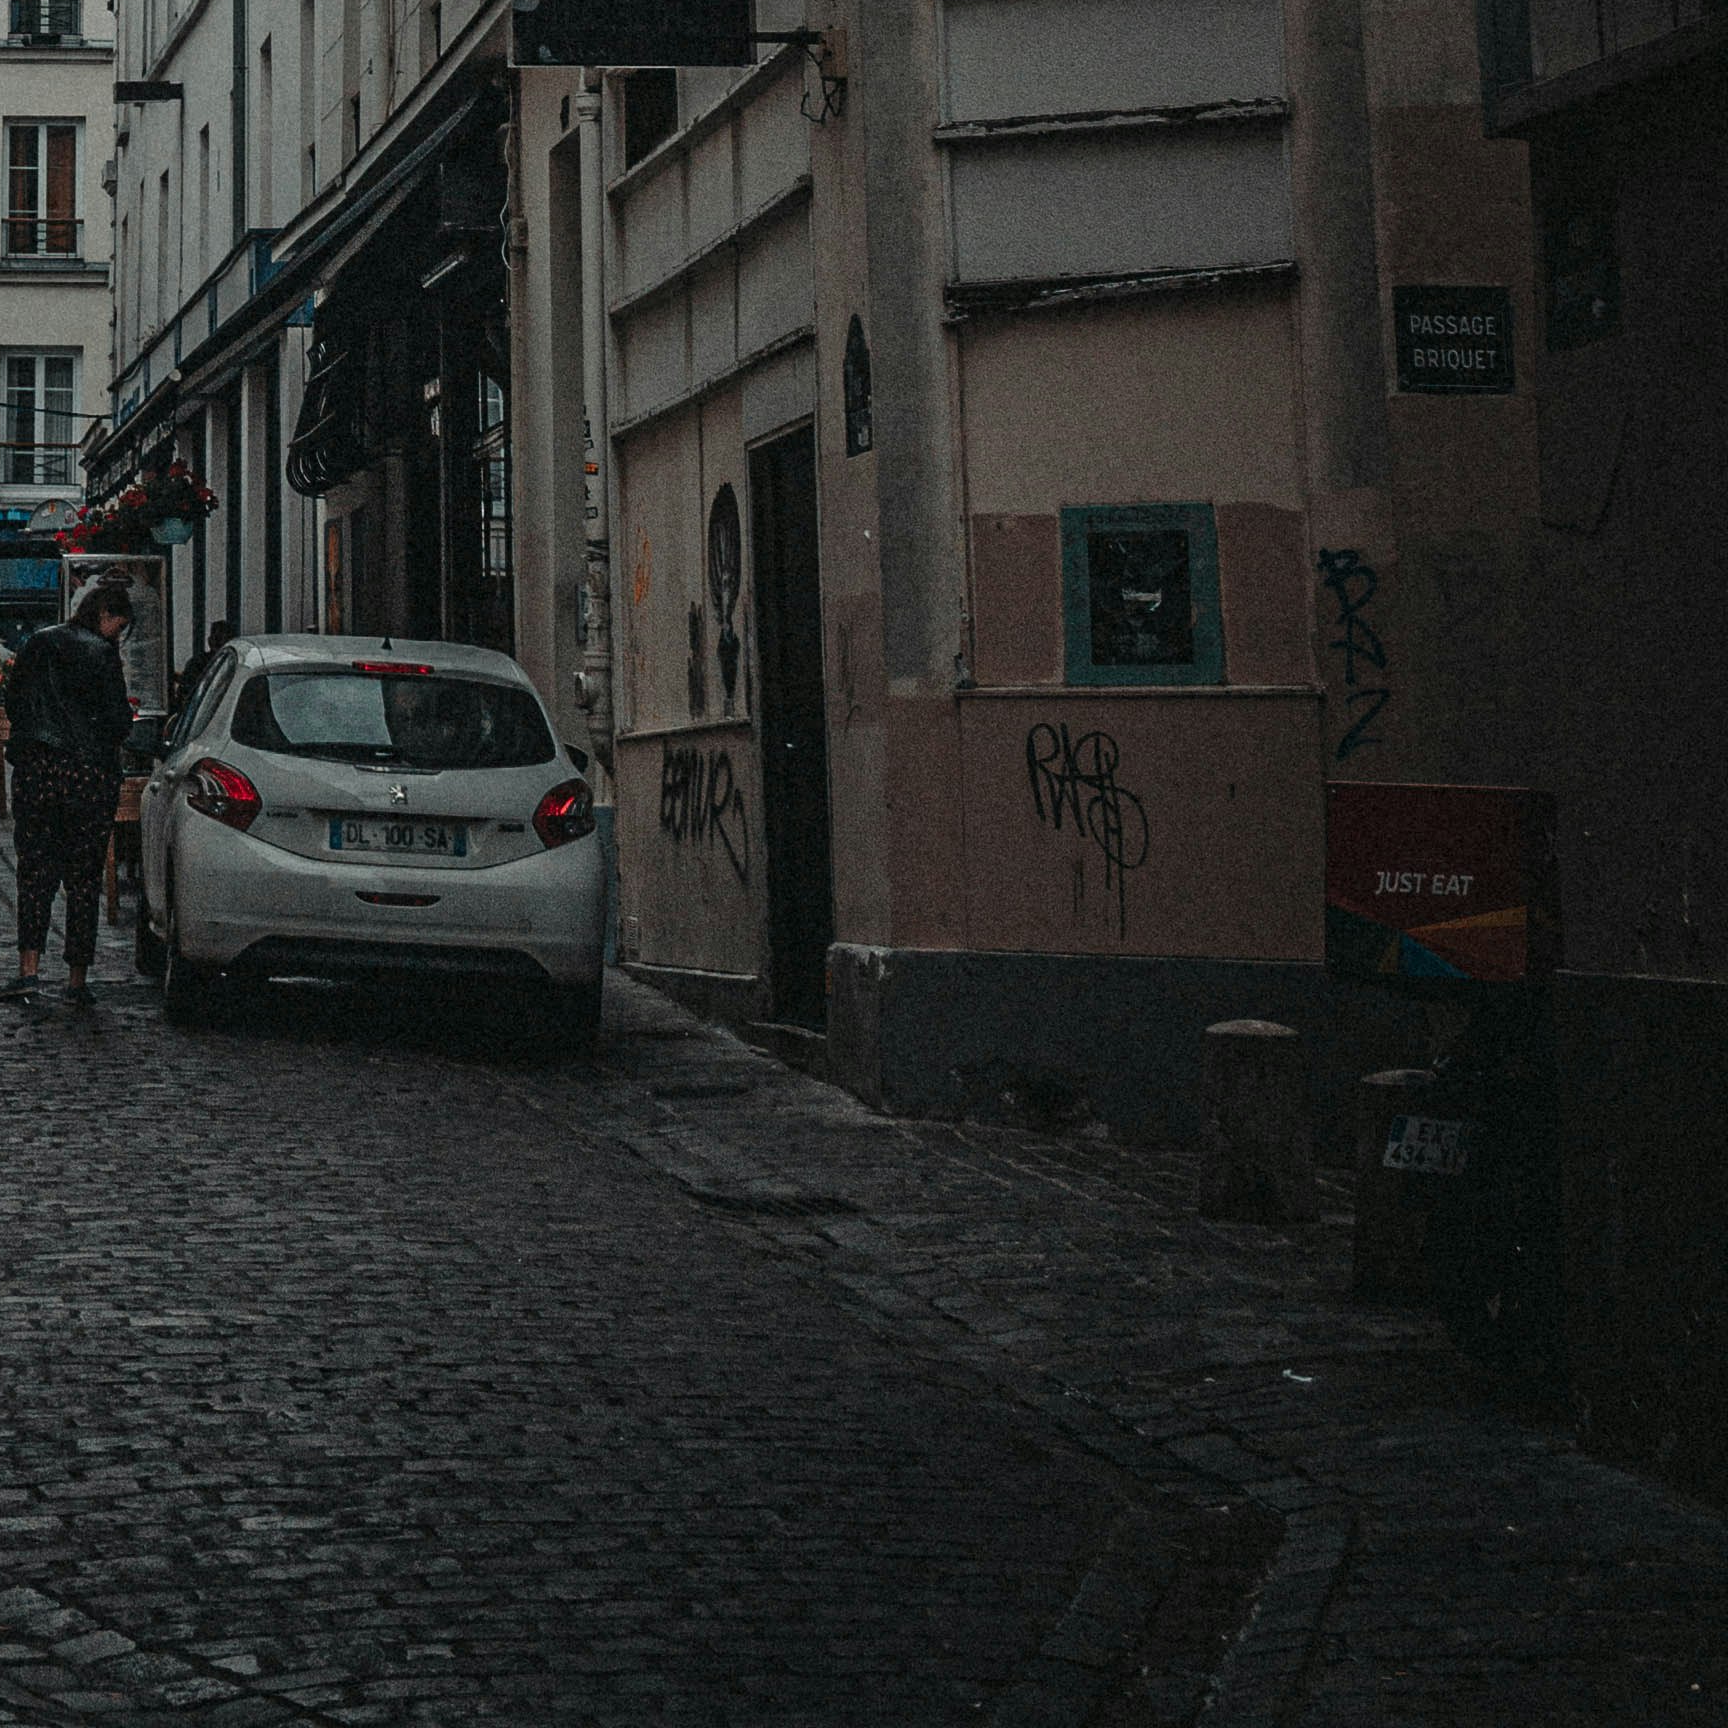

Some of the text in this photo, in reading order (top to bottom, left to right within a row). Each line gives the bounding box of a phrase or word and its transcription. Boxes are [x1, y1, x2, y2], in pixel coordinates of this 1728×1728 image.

[1409, 314, 1497, 336] PASSAGE
[1413, 348, 1497, 370] BRIQUET
[1375, 871, 1474, 896] JUST EAT
